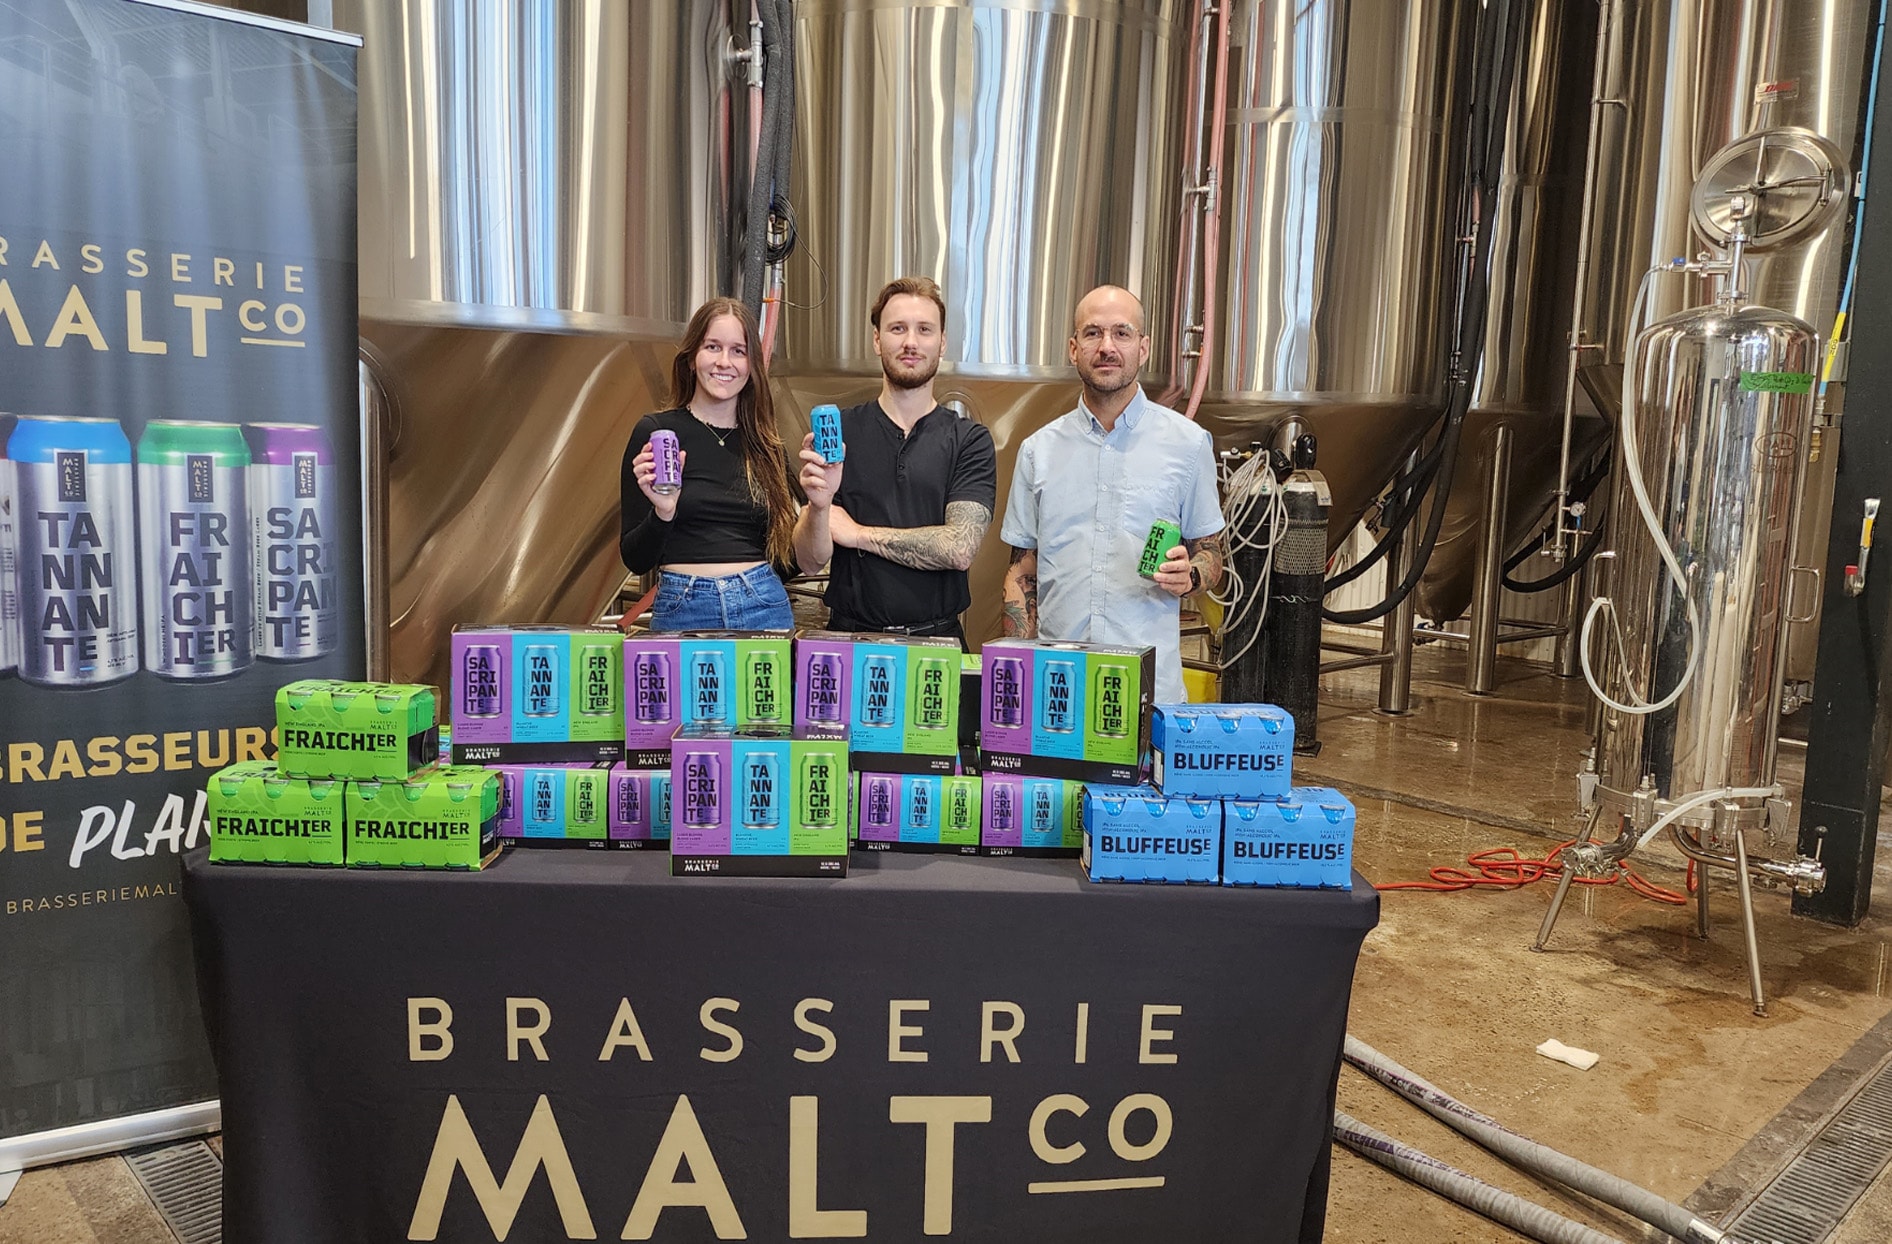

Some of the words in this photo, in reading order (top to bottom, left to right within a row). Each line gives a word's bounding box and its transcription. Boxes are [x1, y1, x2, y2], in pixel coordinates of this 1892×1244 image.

[239, 300, 306, 334] CO
[819, 415, 834, 425] TA
[821, 426, 838, 437] NN
[663, 438, 677, 450] SA
[822, 439, 838, 449] AN
[823, 450, 836, 462] TE
[63, 458, 73, 489] MALT
[193, 461, 202, 491] MALT
[665, 472, 677, 481] TE
[170, 512, 229, 546] FR
[267, 508, 322, 539] SA
[38, 512, 102, 548] TA
[1150, 526, 1165, 539] FR
[1146, 538, 1160, 550] AI
[1142, 550, 1159, 563] CH
[42, 553, 112, 590] NN
[170, 552, 222, 586] AI
[1138, 561, 1155, 572] IER
[42, 594, 109, 630] AN
[173, 591, 233, 626] CH
[266, 616, 310, 647] TE
[174, 629, 237, 665] IER
[44, 636, 98, 672] TE
[469, 657, 488, 669] SA
[531, 657, 548, 669] TA
[589, 657, 608, 669] FR
[698, 663, 715, 675] TA
[754, 663, 772, 674] FR
[640, 664, 658, 675] SA
[813, 664, 830, 676] SA
[870, 667, 887, 679] TA
[996, 669, 1012, 681] SA
[469, 671, 496, 683] CRI
[531, 671, 552, 682] NN
[588, 671, 605, 682] AI
[925, 670, 942, 682] FR
[1050, 673, 1066, 685] TA
[640, 678, 665, 689] CRI
[699, 677, 718, 689] NN
[754, 677, 770, 688] AI
[812, 678, 837, 690] CRI
[869, 681, 889, 692] NN
[995, 682, 1018, 694] CRI
[1104, 677, 1121, 689] FR
[469, 685, 497, 697] PAN
[530, 685, 550, 696] AN
[589, 684, 608, 696] CH
[924, 684, 940, 696] AI
[1050, 687, 1068, 699] NN
[640, 691, 667, 703] PAN
[698, 691, 718, 702] AN
[755, 691, 774, 702] CH
[811, 692, 837, 704] PAN
[868, 695, 887, 707] AN
[995, 696, 1019, 708] PAN
[1103, 691, 1119, 703] AI
[468, 699, 484, 711] TE
[531, 699, 547, 710] TE
[589, 698, 609, 709] IER
[923, 697, 942, 709] CH
[1049, 700, 1067, 712] AN
[640, 705, 654, 717] TE
[699, 705, 714, 716] TE
[755, 704, 775, 716] IER
[811, 705, 824, 717] TE
[868, 708, 882, 720] TE
[995, 709, 1008, 720] TE
[1103, 704, 1122, 717] CH
[923, 711, 942, 722] IER
[1049, 714, 1063, 725] TE
[1103, 718, 1122, 730] IER
[285, 730, 397, 751] FRAICHIER
[0, 726, 279, 783] RASSEUR
[1174, 753, 1284, 771] BLUFFEUSE
[688, 765, 708, 777] SA
[751, 765, 768, 777] TA
[810, 766, 828, 778] FR
[538, 781, 549, 789] TA
[580, 782, 592, 790] FR
[621, 783, 633, 791] SA
[688, 780, 715, 792] CRI
[751, 780, 772, 792] NN
[809, 780, 826, 792] AI
[873, 785, 885, 793] SA
[538, 791, 551, 799] NN
[621, 793, 637, 801] CRI
[915, 787, 926, 796] TA
[955, 789, 967, 797] FR
[537, 800, 550, 808] AN
[580, 801, 593, 809] CH
[688, 794, 717, 806] PAN
[750, 794, 770, 807] AN
[810, 794, 829, 807] CH
[872, 795, 888, 803] CRI
[872, 804, 889, 812] PAN
[954, 808, 967, 816] CH
[688, 808, 703, 821] TE
[750, 809, 766, 821] TE
[809, 809, 830, 821] IER
[0, 811, 45, 852] E
[69, 790, 211, 868] PLAI
[217, 817, 331, 837] FRAICHIER
[355, 820, 469, 840] FRAICHIER
[1101, 836, 1210, 855] BLUFFEUSE
[1234, 841, 1344, 860] BLUFFEUSE
[7, 879, 182, 914] BRASSERIEMAL
[407, 997, 1182, 1063] BRASSERIE
[407, 1094, 992, 1242] MALT
[1028, 1092, 1173, 1165] CO
